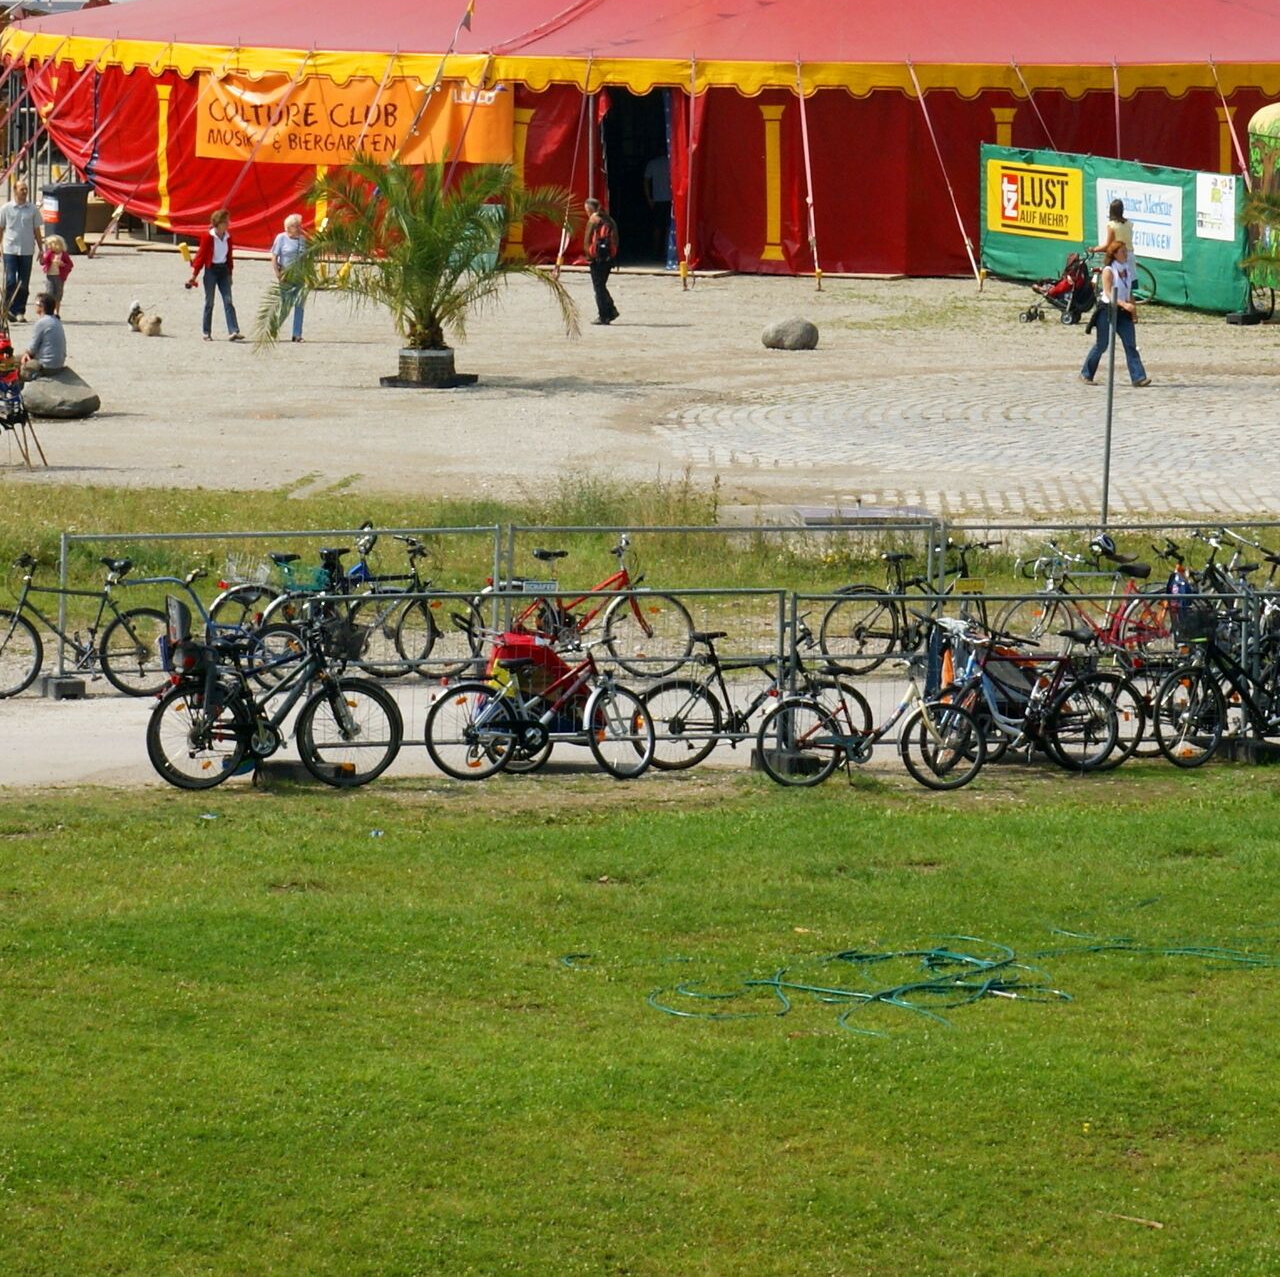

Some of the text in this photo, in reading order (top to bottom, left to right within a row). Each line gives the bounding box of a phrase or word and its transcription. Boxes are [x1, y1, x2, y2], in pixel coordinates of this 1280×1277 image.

[208, 98, 398, 128] CULTURE CLUB
[1020, 175, 1069, 210] LUST
[1020, 209, 1069, 228] AUF MEHR?
